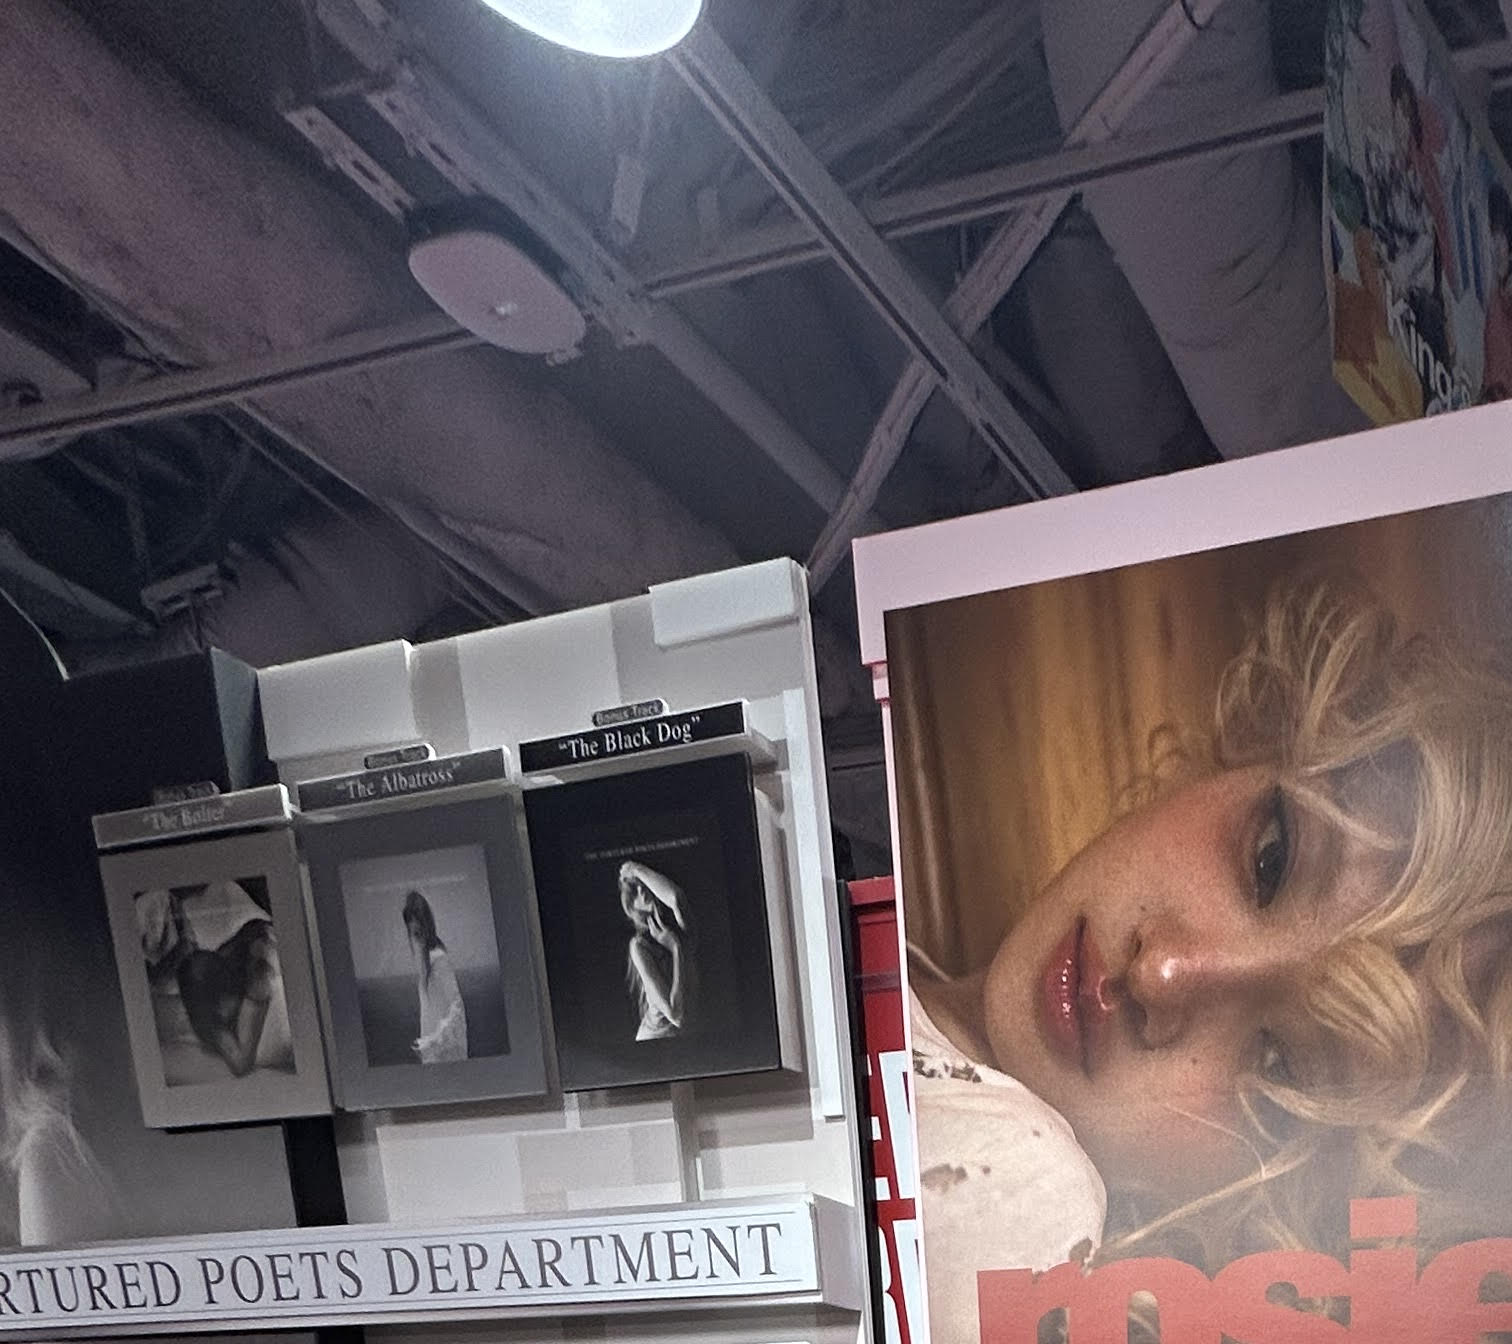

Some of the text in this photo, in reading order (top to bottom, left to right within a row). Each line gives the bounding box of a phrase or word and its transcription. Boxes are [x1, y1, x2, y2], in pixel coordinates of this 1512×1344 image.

[604, 728, 651, 753] Black
[197, 1249, 363, 1304] POETS
[382, 1223, 782, 1296] DEPARTMENT
